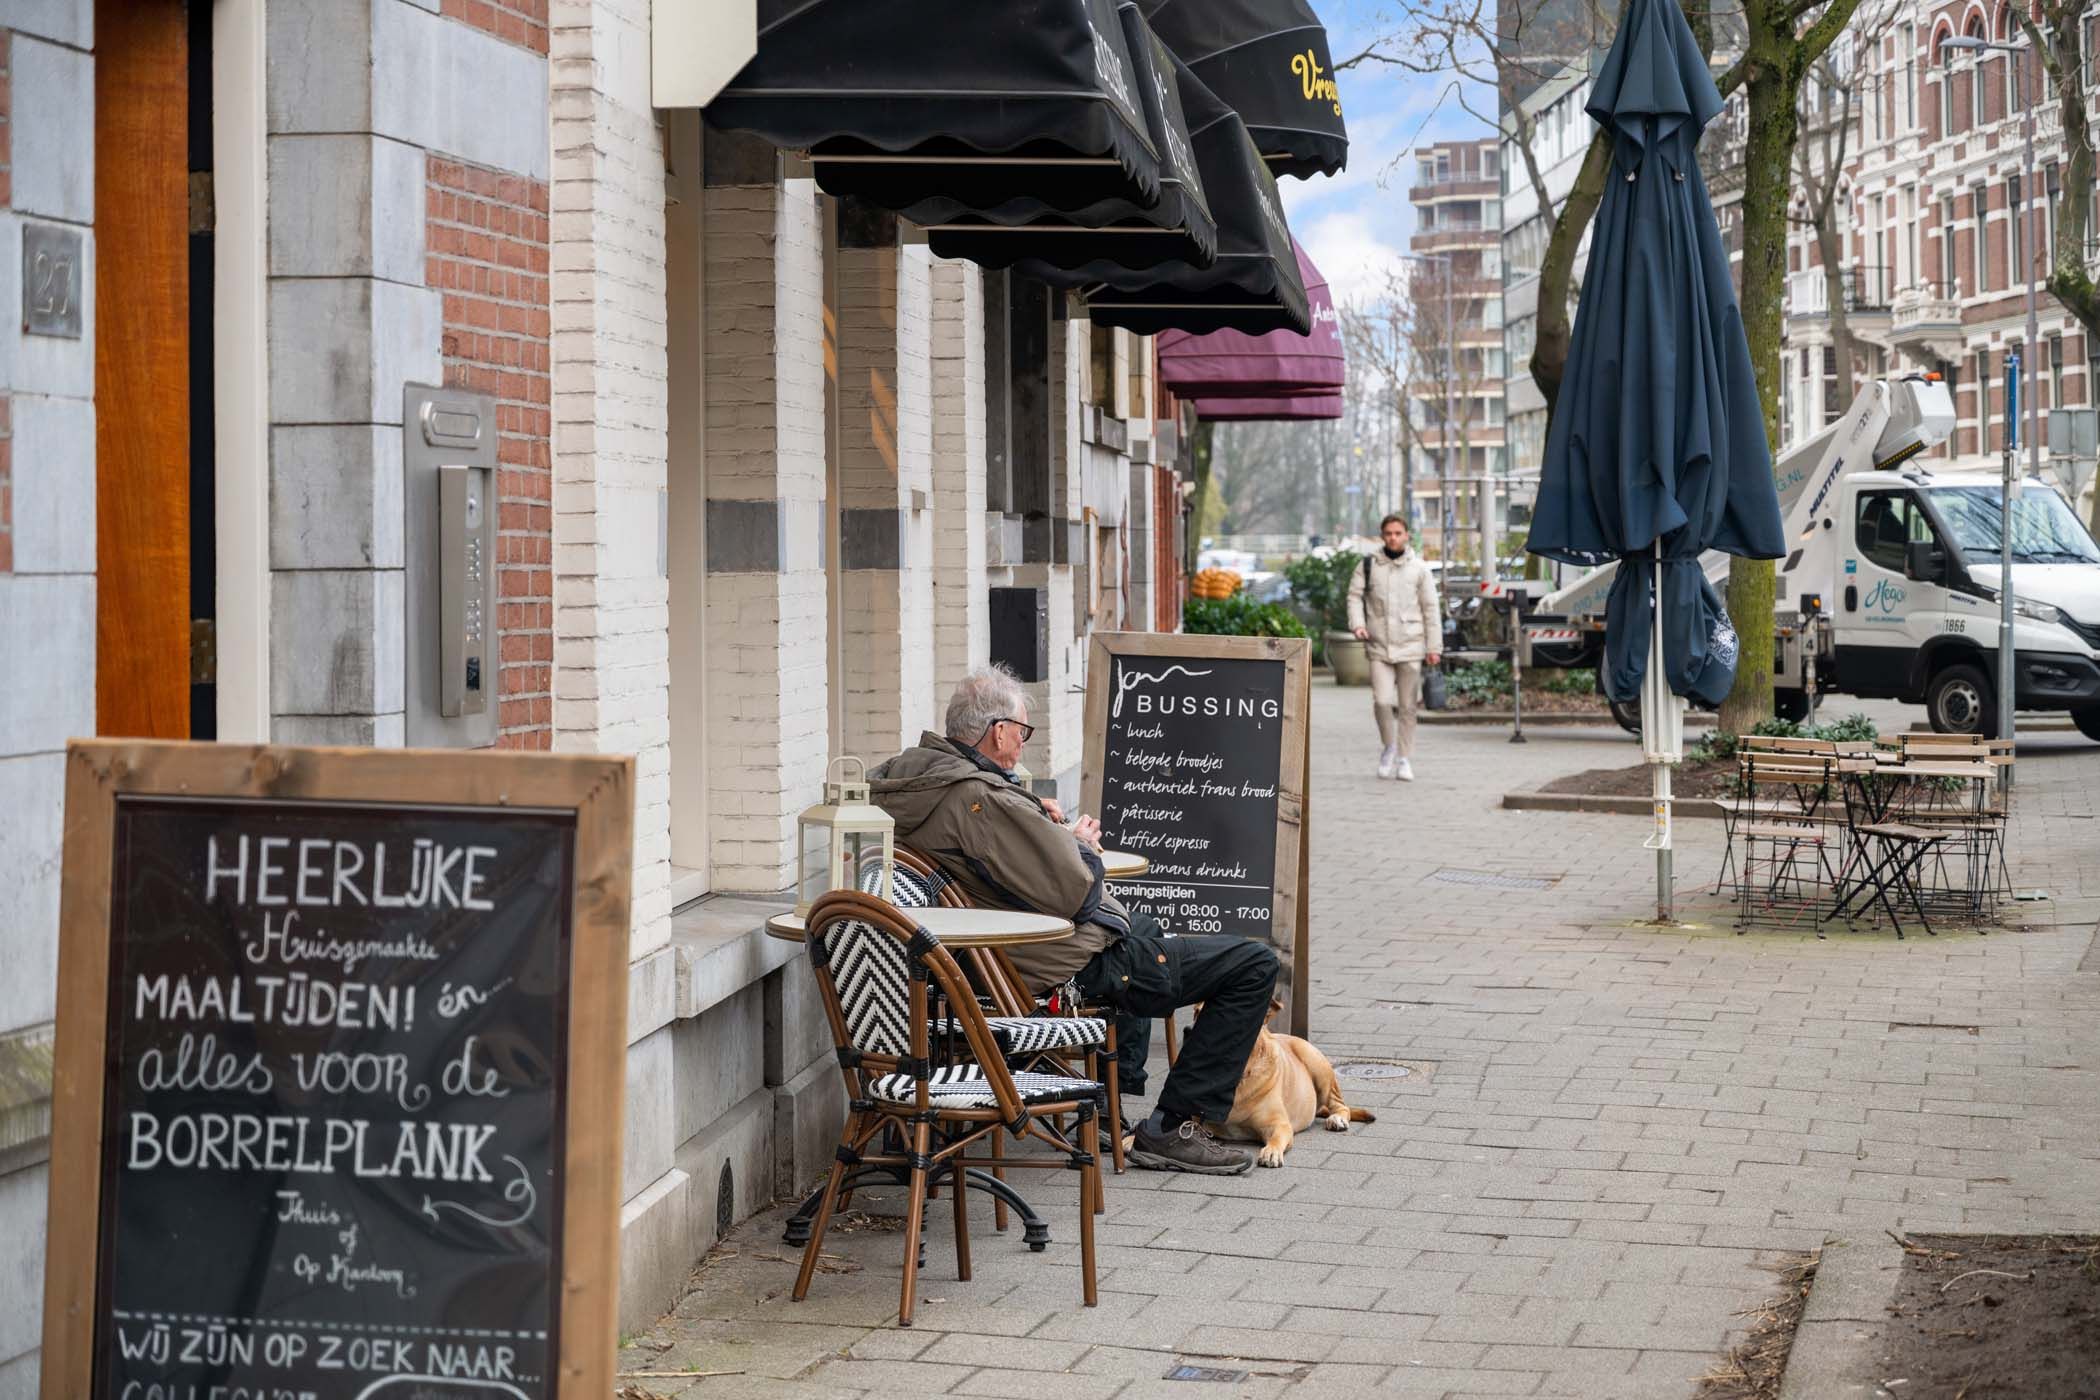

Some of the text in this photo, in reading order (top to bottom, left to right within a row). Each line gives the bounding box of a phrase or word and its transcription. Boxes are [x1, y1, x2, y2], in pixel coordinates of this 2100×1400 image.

[1137, 695, 1278, 718] BUSSING
[1127, 722, 1164, 738] lunch
[1125, 748, 1224, 773] belegde broodjes
[1123, 776, 1276, 798] authentiek frans brood
[1120, 803, 1183, 824] pâtisserie
[1120, 829, 1211, 854] koffie/espresso
[1104, 882, 1196, 900] Openingstijden
[1156, 903, 1175, 917] vrij
[1180, 903, 1219, 918] 08:00
[1236, 907, 1270, 920] 17:00
[1187, 919, 1222, 933] 15:00
[246, 910, 440, 973] Huisgemaakte
[138, 1033, 273, 1093] alles
[441, 1036, 510, 1098] de
[127, 1112, 497, 1183] BORRELPLANK
[276, 1189, 340, 1224] Thuis
[338, 1223, 358, 1256] of
[294, 1253, 321, 1284] Op
[118, 1323, 170, 1364] WIJ
[180, 1325, 254, 1367] ZIJN
[264, 1332, 308, 1368] OP
[316, 1336, 414, 1373] ZOEK
